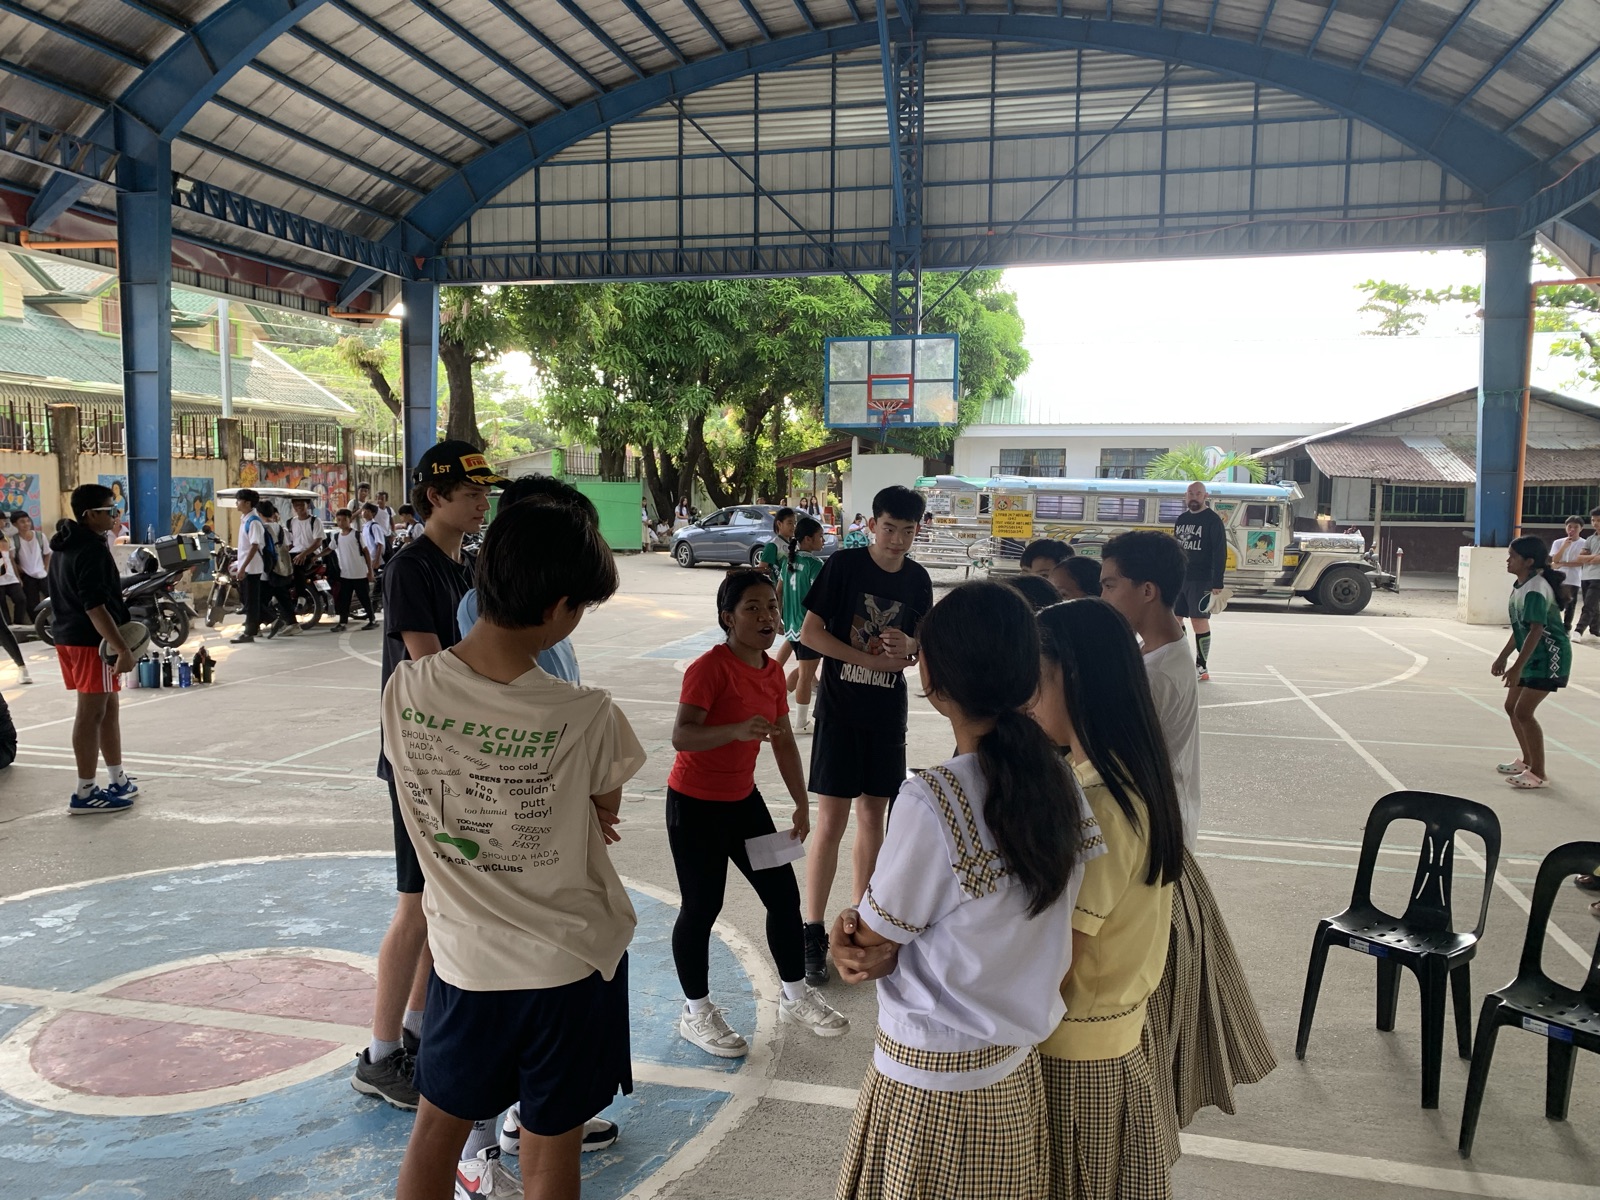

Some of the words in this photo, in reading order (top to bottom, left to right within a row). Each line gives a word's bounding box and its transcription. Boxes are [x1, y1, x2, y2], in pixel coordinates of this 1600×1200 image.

[432, 462, 451, 474] 1ST
[840, 663, 872, 685] DRAGON
[401, 707, 456, 731] GOLF
[462, 722, 559, 743] EXCUSE
[401, 729, 443, 743] SHOULD'A
[409, 741, 434, 751] HAD'A
[479, 741, 555, 758] SHIRT
[405, 751, 444, 763] ULLIGAN
[445, 745, 460, 755] too
[463, 755, 490, 771] noisy
[518, 763, 538, 771] cold
[469, 773, 501, 784] GREENS
[525, 773, 554, 784] SLOW!
[475, 782, 493, 795] TOO
[509, 783, 556, 796] couldn't
[465, 787, 497, 804] WINDY
[520, 798, 545, 810] putt
[480, 807, 508, 816] humid
[514, 806, 552, 820] today!
[472, 821, 493, 829] MANY
[511, 823, 552, 834] GREENS
[518, 833, 540, 842] TOO
[511, 840, 541, 850] FAST!
[482, 851, 527, 862] SHOULD'A
[530, 849, 559, 860] HAD'A
[491, 863, 523, 873] CLUBS
[533, 857, 560, 868] DROP
